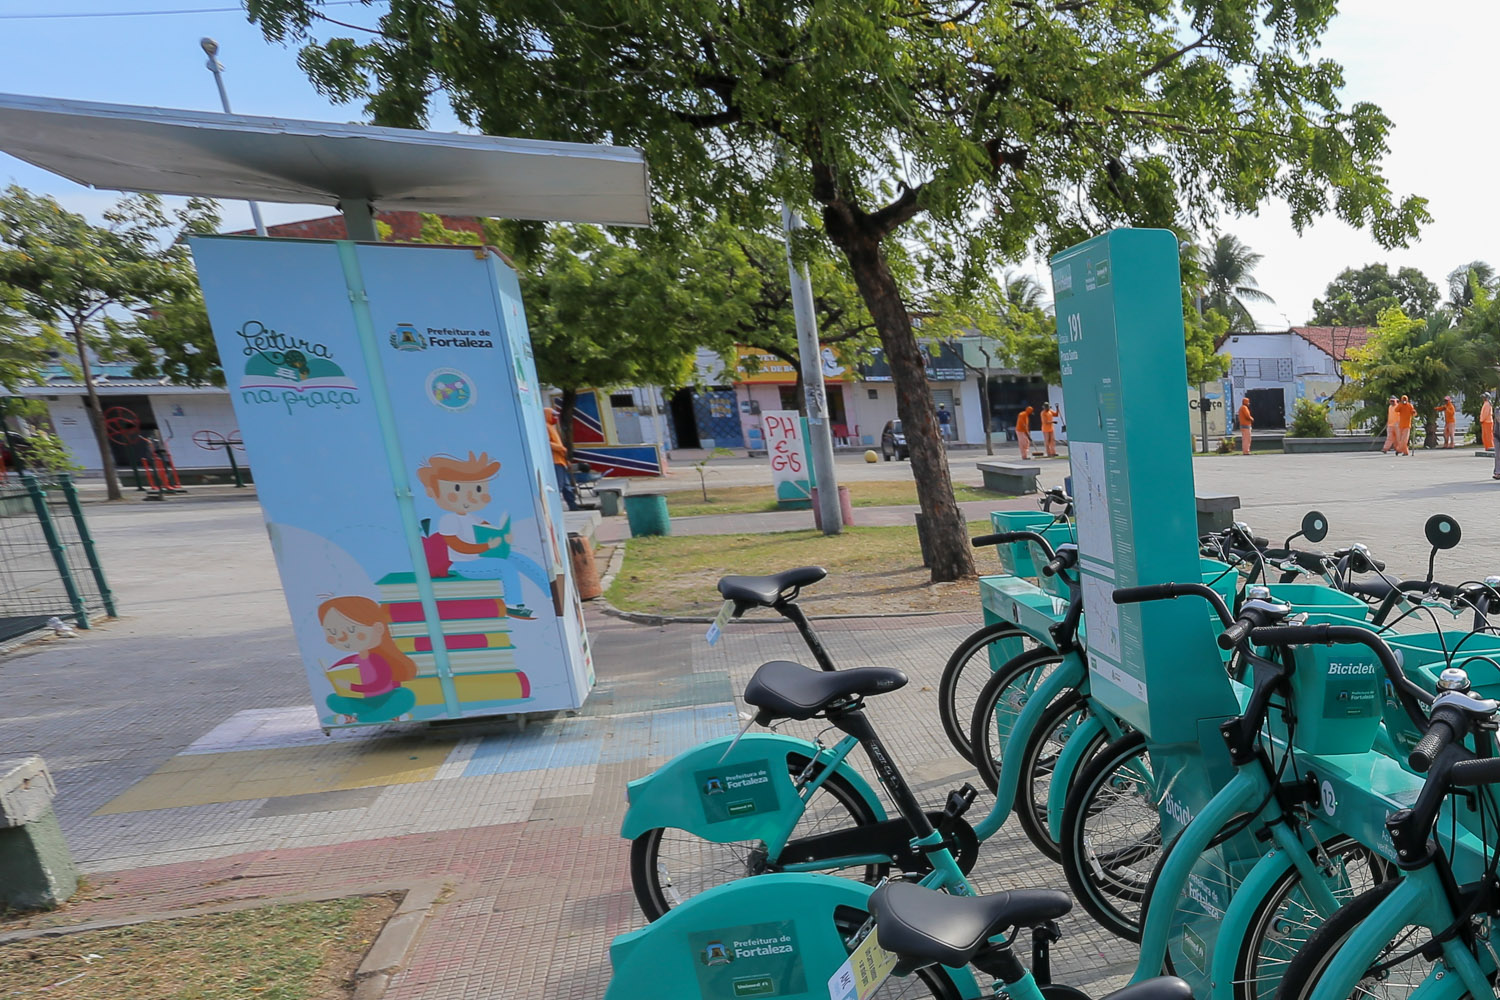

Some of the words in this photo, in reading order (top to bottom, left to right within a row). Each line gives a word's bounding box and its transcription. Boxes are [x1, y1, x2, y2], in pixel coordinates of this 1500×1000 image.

[427, 328, 476, 337] Prefeitura
[478, 328, 491, 337] de
[1068, 312, 1082, 342] 191
[236, 320, 333, 365] Leitura
[429, 336, 493, 349] Fortaleza
[241, 389, 280, 405] na
[282, 388, 360, 415] praça
[765, 416, 796, 439] PH
[1327, 662, 1375, 675] Biciclet
[727, 776, 769, 789] Fortaleza
[1323, 788, 1335, 809] 12
[1165, 791, 1196, 827] Bicicl
[733, 937, 778, 948] Prefeitura
[735, 944, 793, 959] Fortaleza
